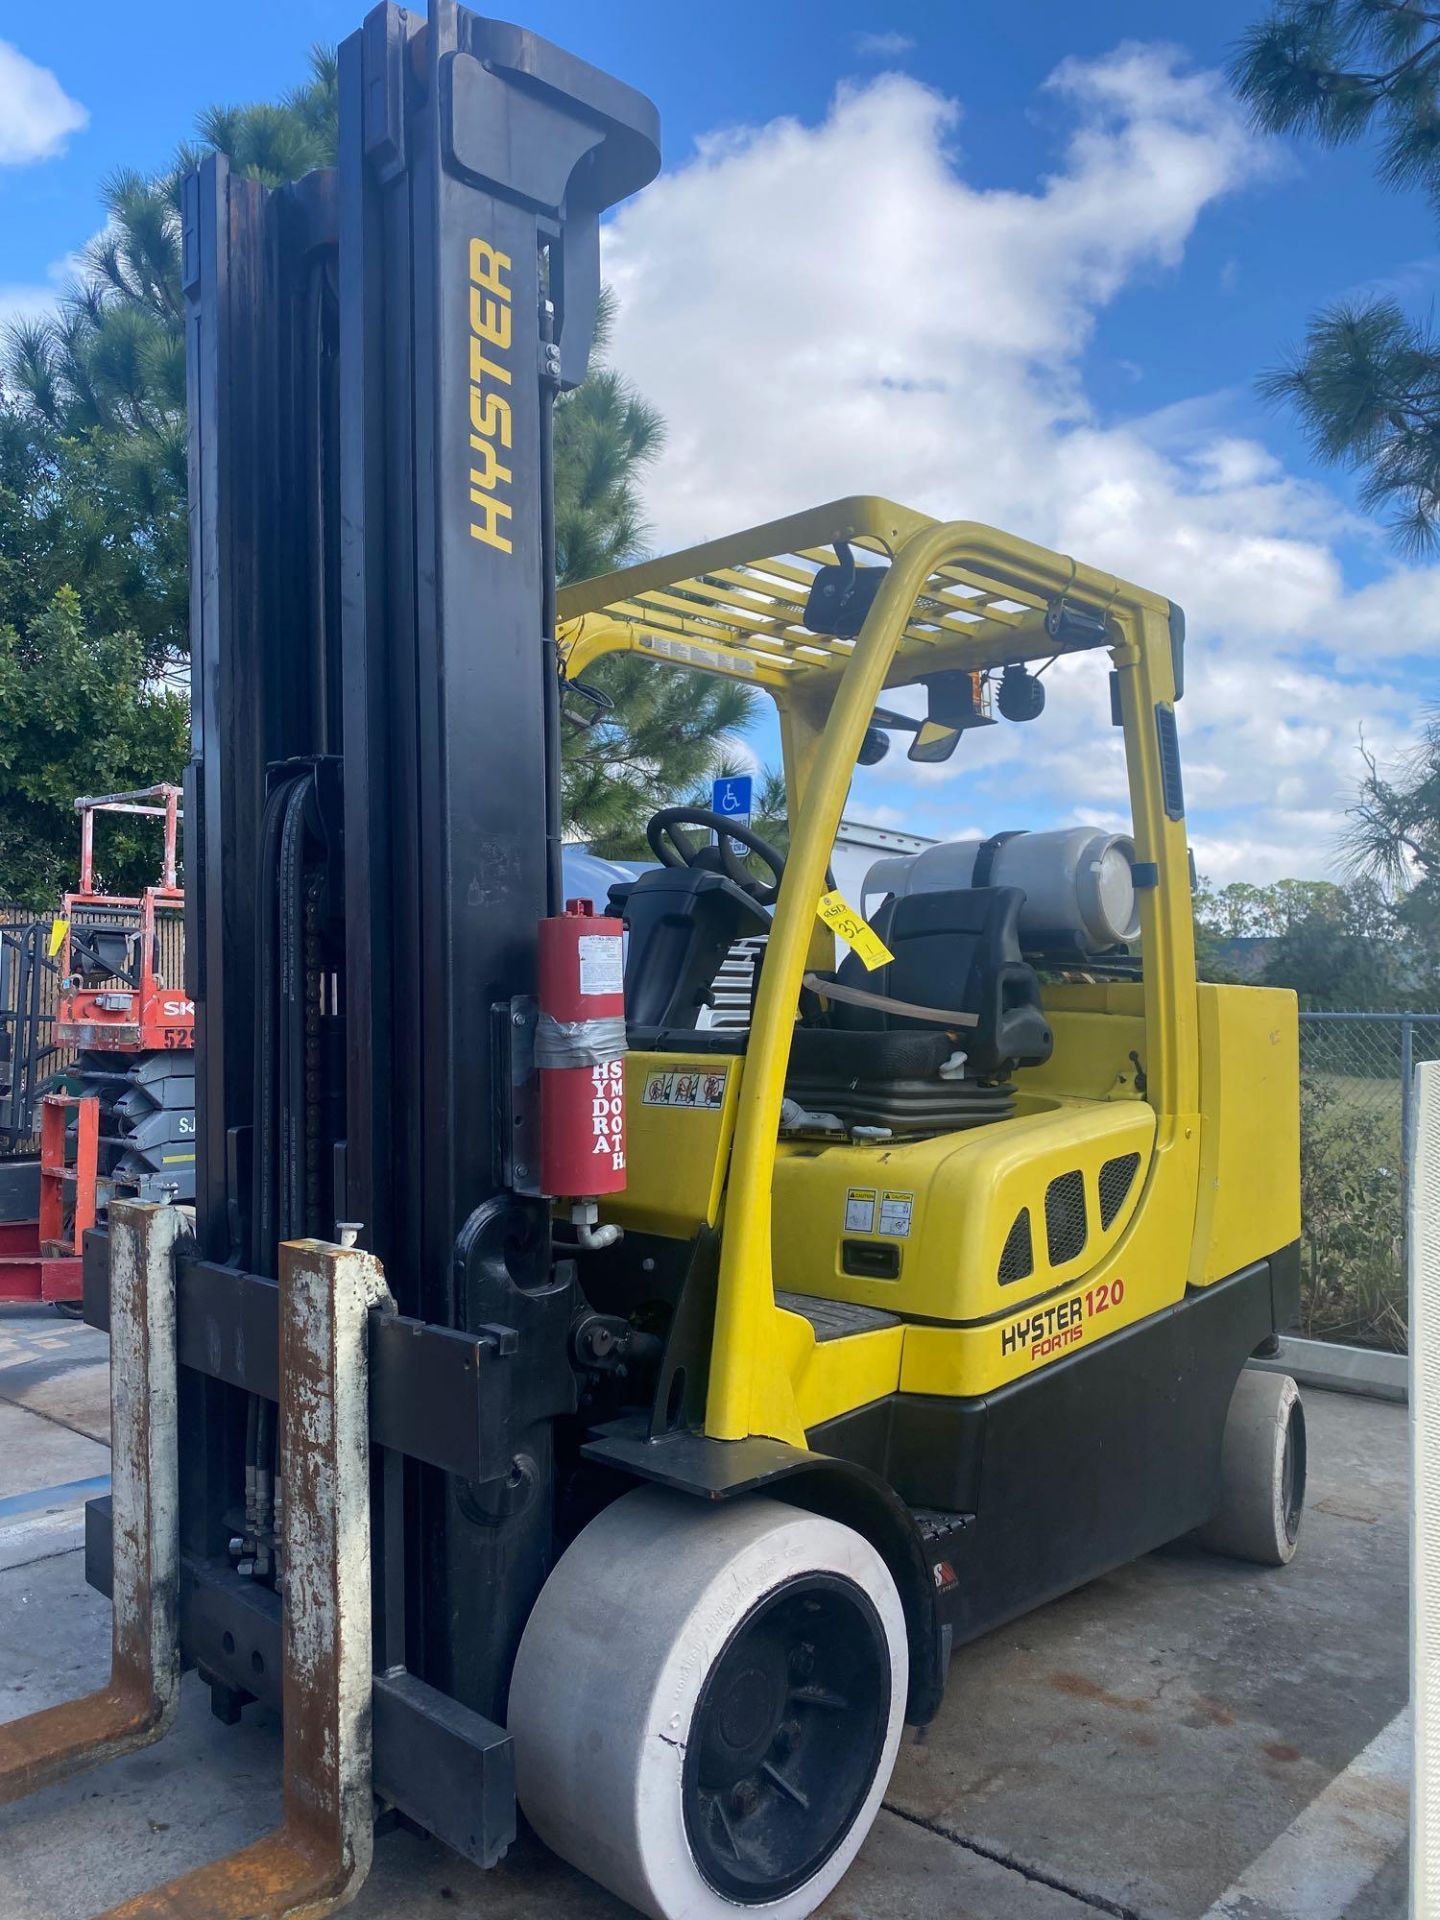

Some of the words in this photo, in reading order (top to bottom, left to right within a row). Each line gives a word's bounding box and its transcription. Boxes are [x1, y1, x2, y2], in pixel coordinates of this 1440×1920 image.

[470, 238, 512, 554] HYSTER
[839, 920, 865, 938] 32
[592, 1062, 611, 1154] HYDRA
[610, 1061, 624, 1170] SMOOTH
[1002, 1297, 1082, 1356] HYSTER
[1085, 1279, 1124, 1317] 120
[1032, 1325, 1083, 1361] FORTIS
